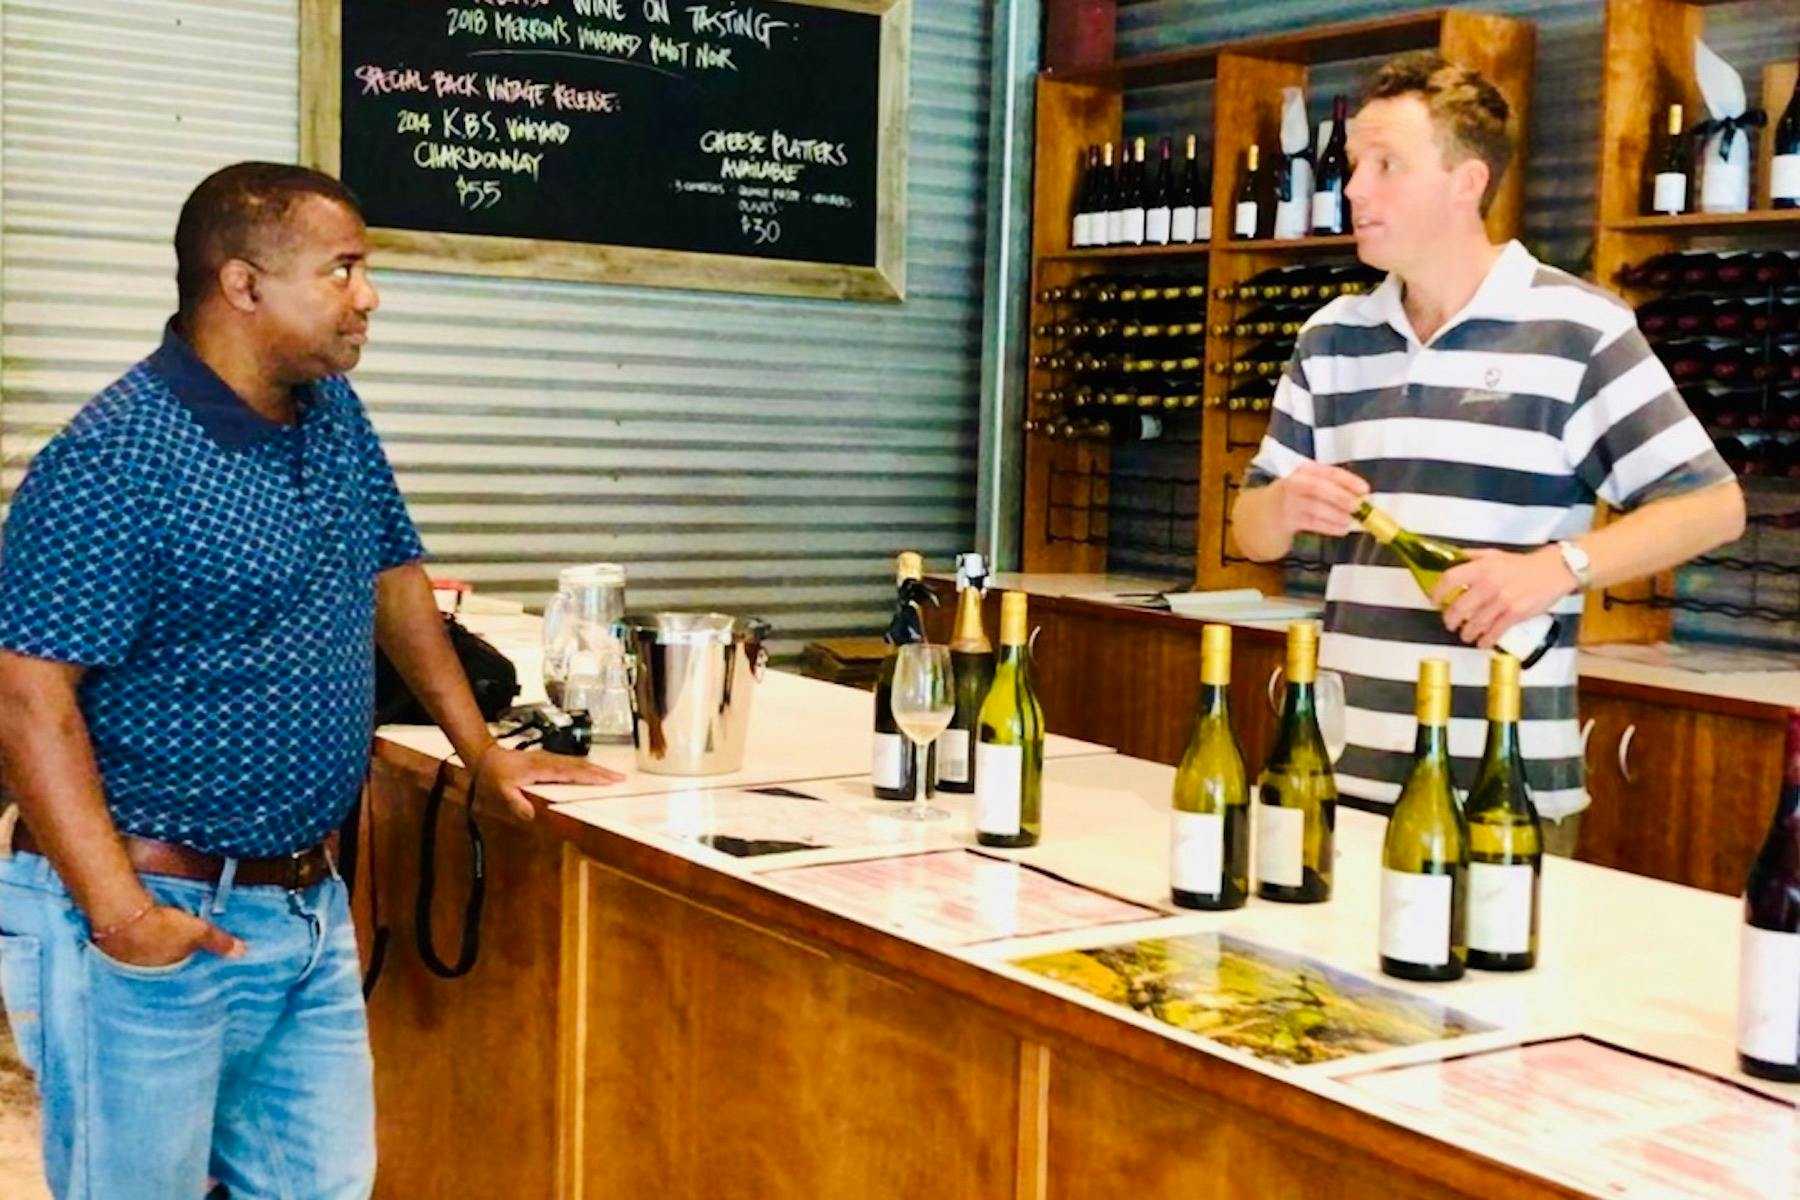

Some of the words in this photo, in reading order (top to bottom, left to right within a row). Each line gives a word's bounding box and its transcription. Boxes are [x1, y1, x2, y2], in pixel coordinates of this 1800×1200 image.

[447, 8, 488, 36] 2018
[573, 0, 627, 21] WINE
[642, 0, 671, 25] ON
[354, 63, 430, 96] SPECIAL
[430, 69, 480, 98] BACK
[397, 109, 432, 135] 2014
[413, 141, 544, 182] CHARDONNAY
[700, 130, 768, 153] CHEESE
[772, 129, 849, 166] PLATTERS
[720, 156, 805, 183] AVAILABLE
[455, 174, 502, 211] $55
